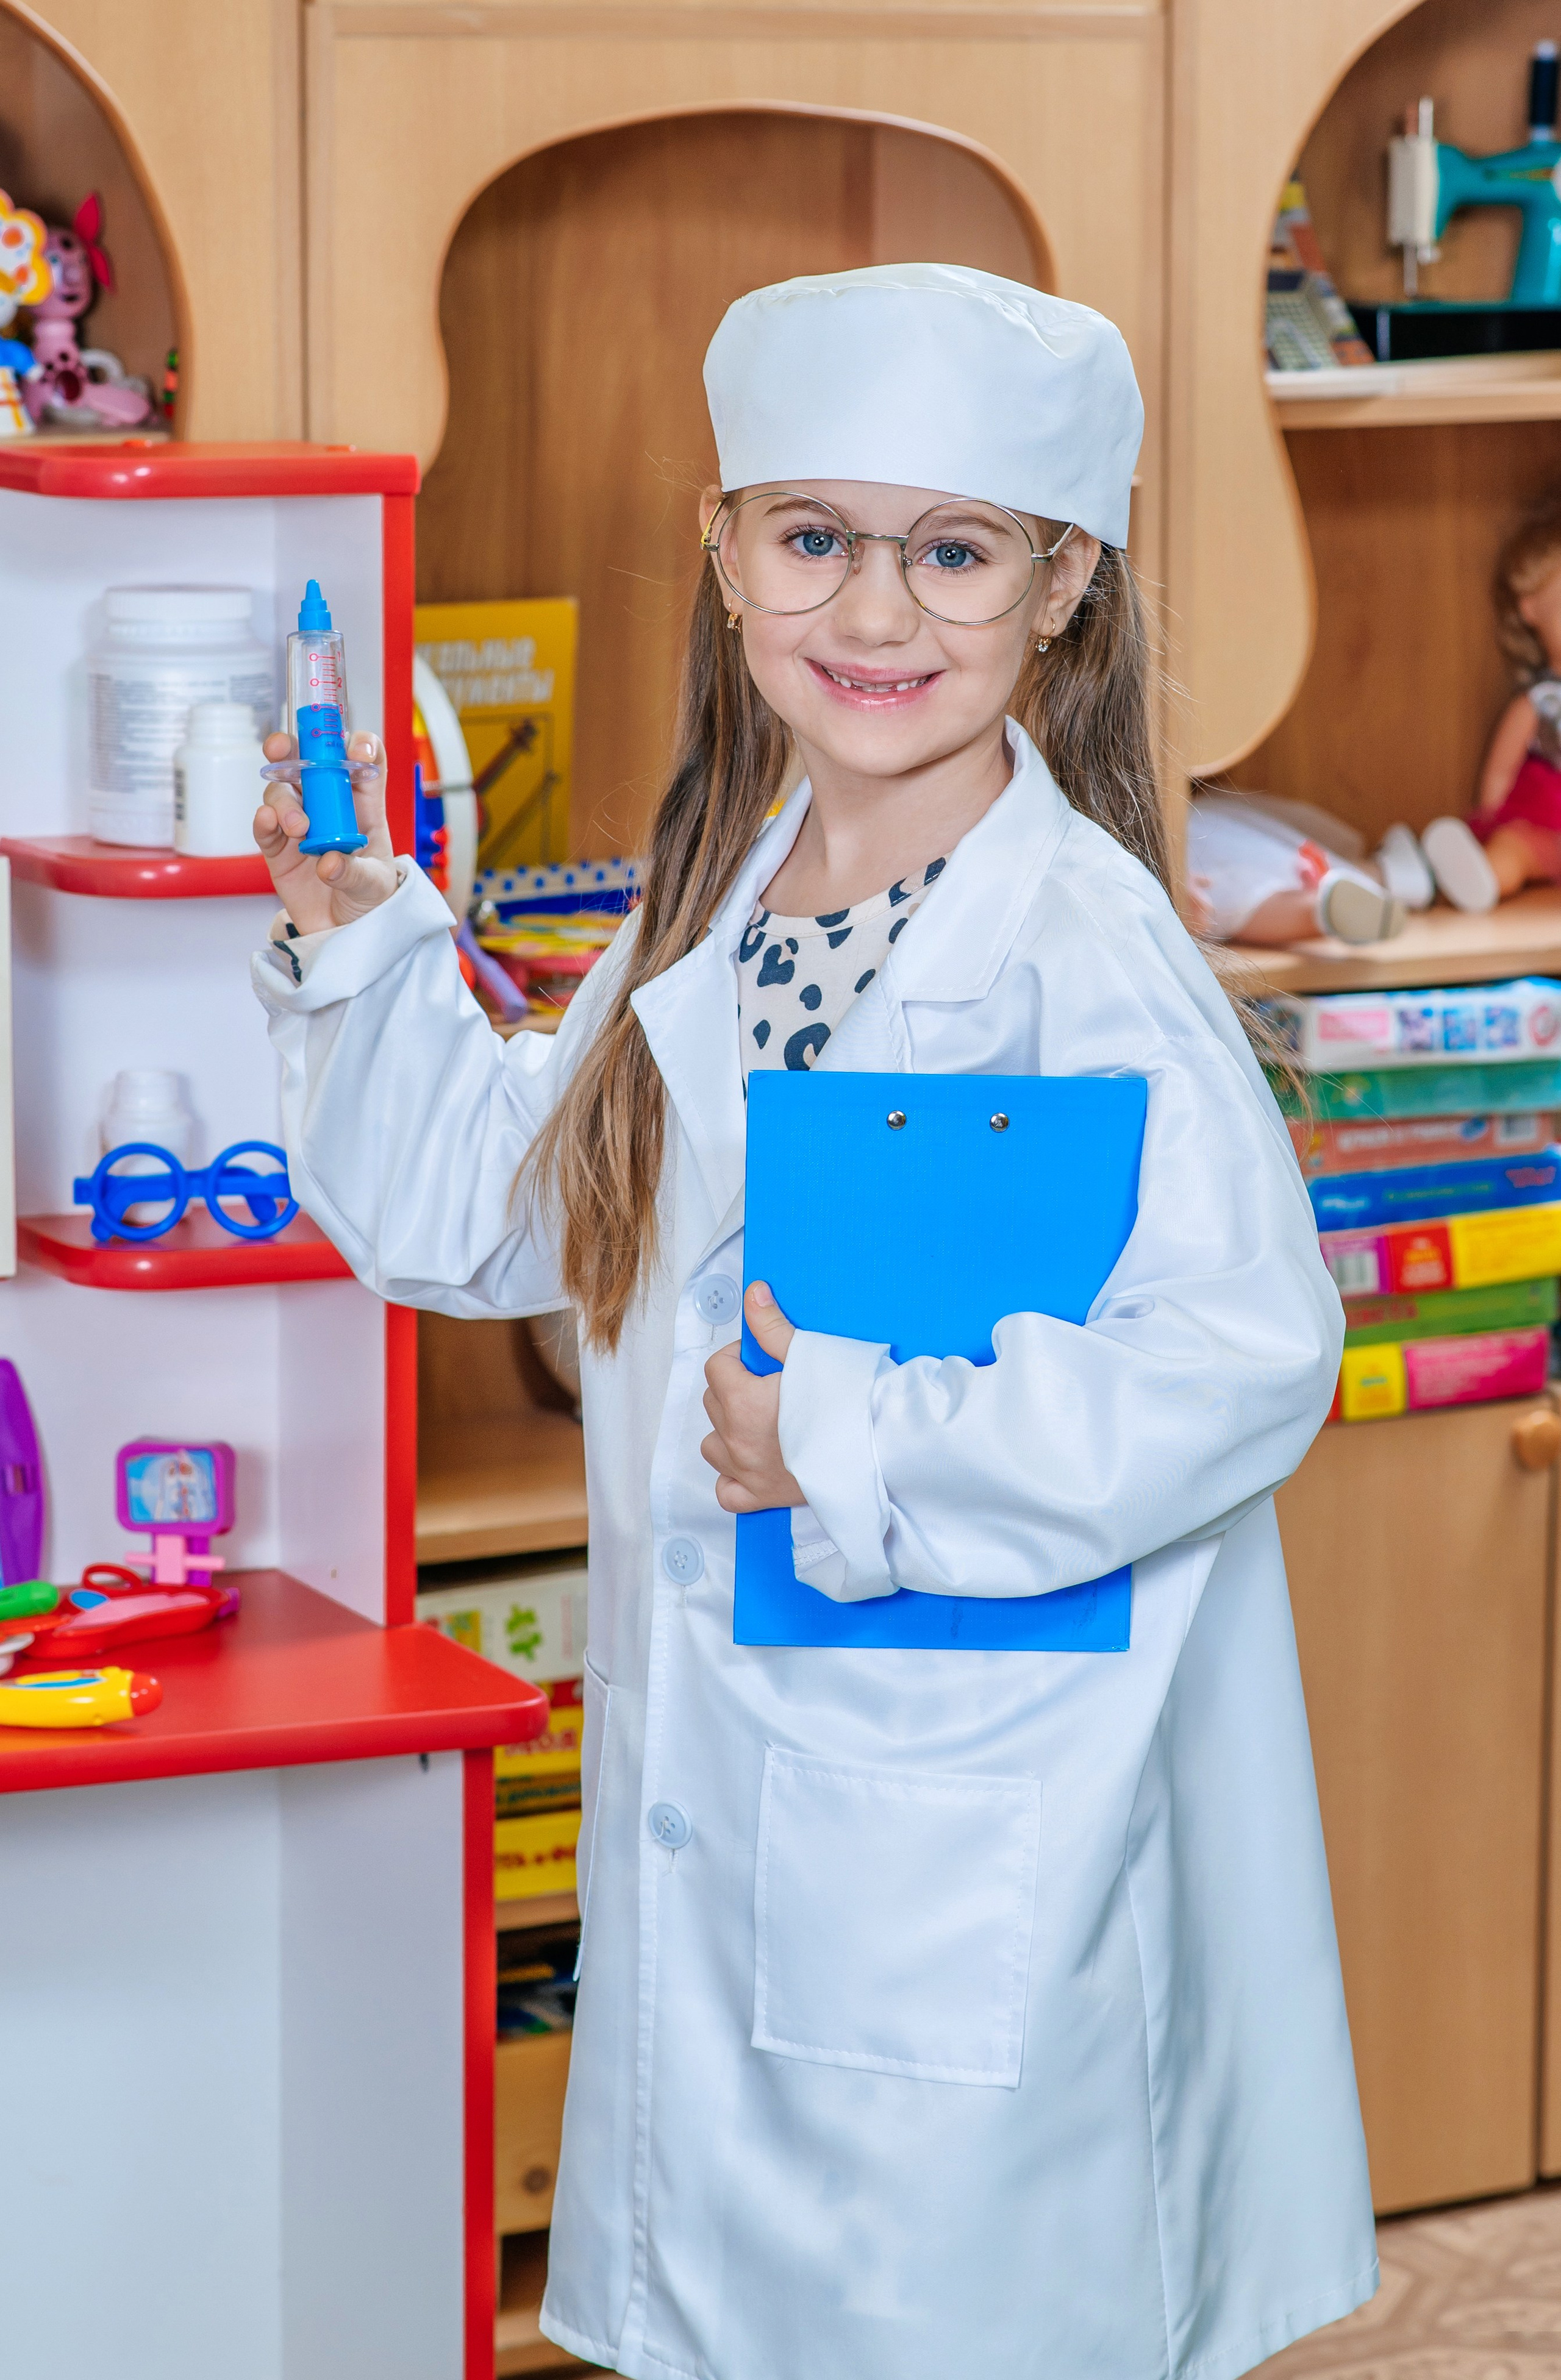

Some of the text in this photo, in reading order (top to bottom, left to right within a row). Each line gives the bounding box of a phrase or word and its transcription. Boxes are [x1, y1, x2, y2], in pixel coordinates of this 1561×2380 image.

[337, 651, 341, 662] 1
[337, 677, 342, 688] 2
[338, 704, 343, 714] 3
[340, 730, 345, 739] 4
